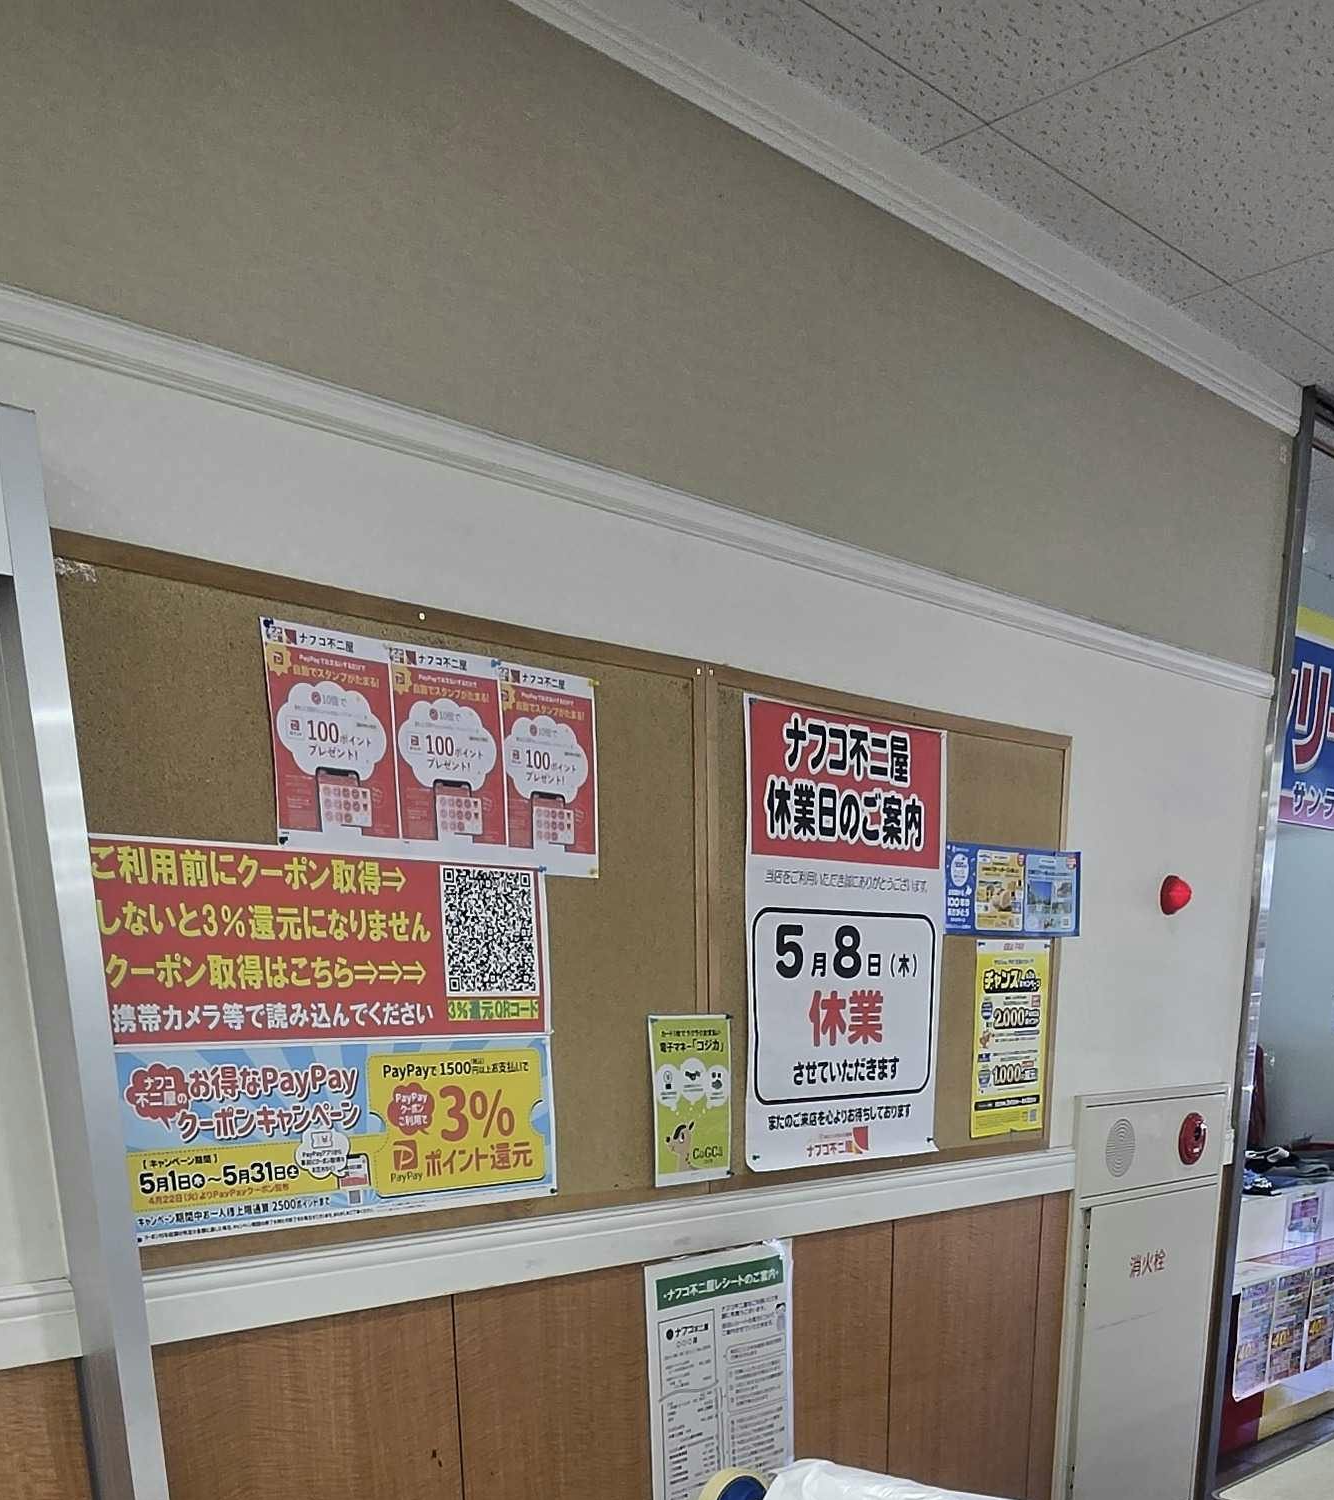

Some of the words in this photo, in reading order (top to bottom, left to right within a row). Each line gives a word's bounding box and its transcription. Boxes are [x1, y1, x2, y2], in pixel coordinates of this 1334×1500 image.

[299, 632, 354, 653] ナフコ不二屋
[418, 654, 467, 671] ナフコ不二屋
[522, 674, 565, 690] ナフコ不二屋
[307, 719, 339, 744] 100
[426, 734, 454, 757] 100
[525, 749, 551, 770] 100
[785, 716, 909, 784] ナフコ不二屋
[766, 778, 923, 848] 休業日のご案内
[95, 899, 432, 943] しないと3%還元になりません
[112, 1002, 434, 1033] 携帯カメラ等で読み込んでください
[809, 989, 884, 1048] 休業
[143, 1076, 174, 1091] ナフコ
[187, 1065, 357, 1099] お得なPayPay
[793, 1056, 900, 1085] させていただきます
[395, 1093, 428, 1104] PayPay
[177, 1102, 360, 1141] クーポンキャンペーン
[439, 1085, 515, 1142] 3%
[768, 1103, 912, 1131] またのご来店を心よりお待ちしております
[425, 1141, 533, 1178] ポイント還元
[390, 1171, 423, 1183] PayPay
[1129, 1248, 1167, 1280] 消火栓
